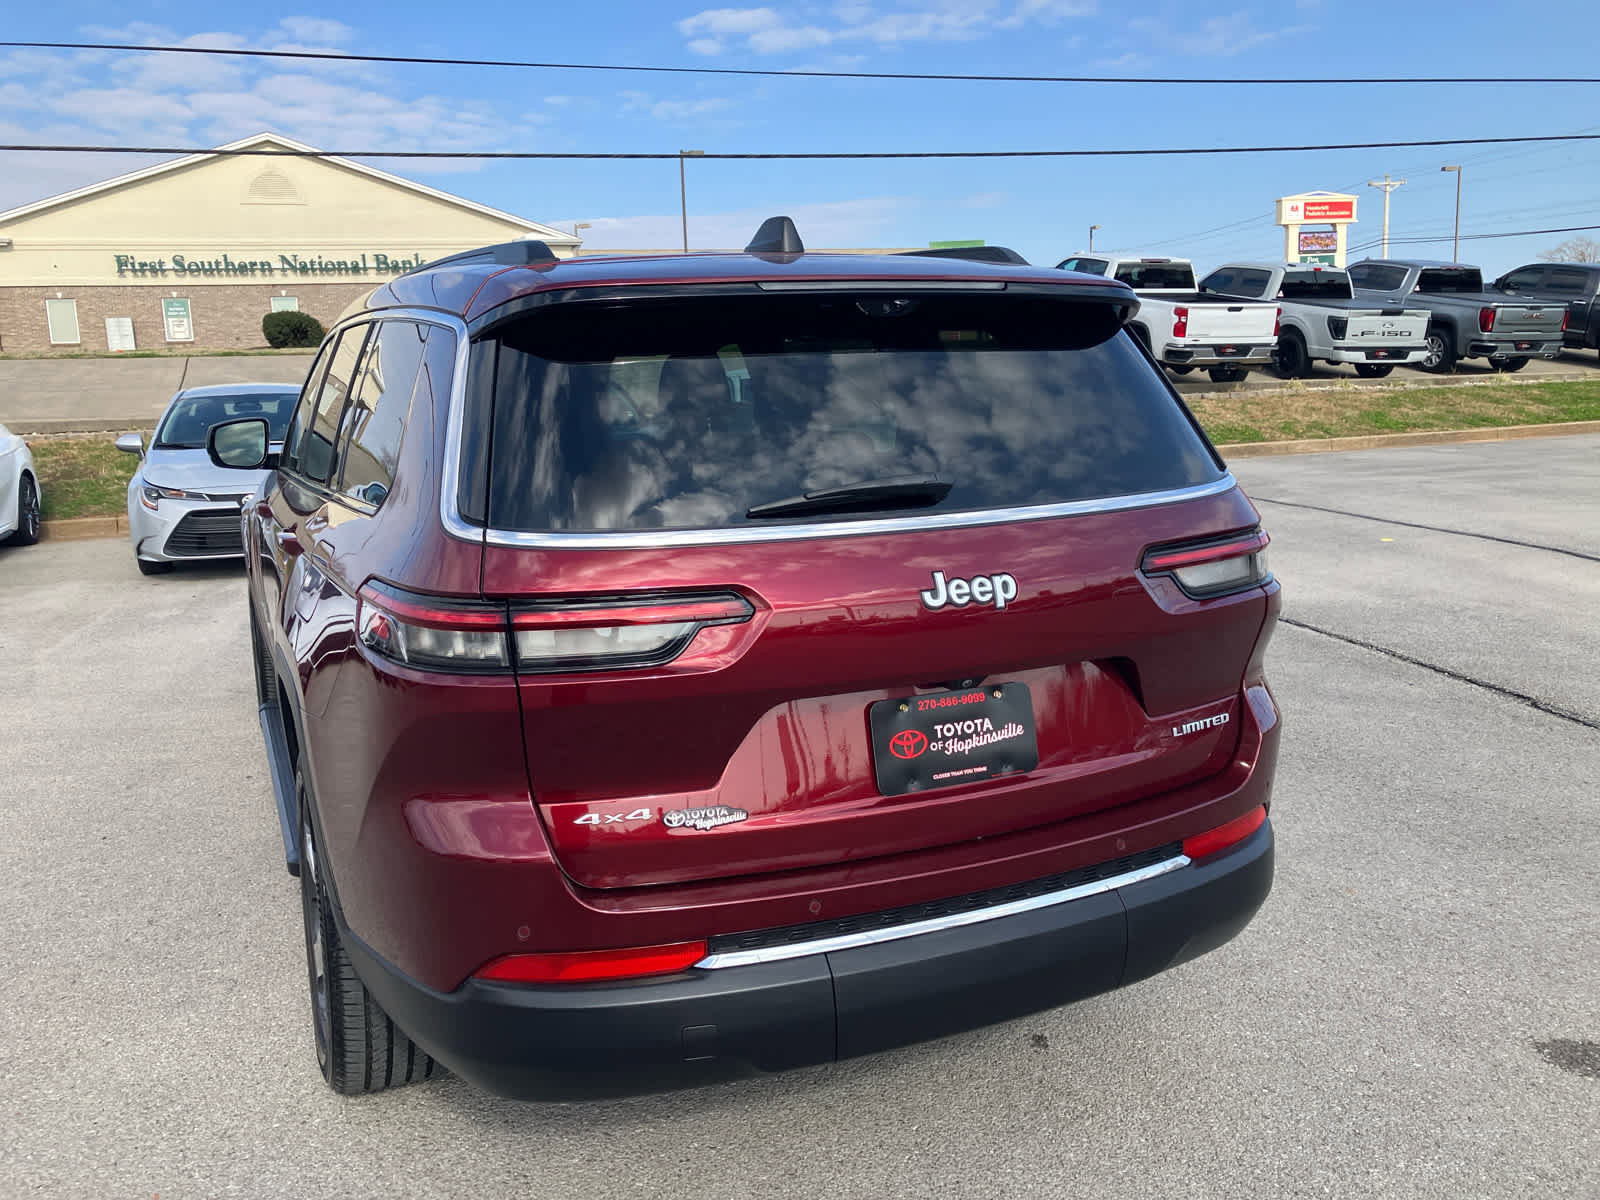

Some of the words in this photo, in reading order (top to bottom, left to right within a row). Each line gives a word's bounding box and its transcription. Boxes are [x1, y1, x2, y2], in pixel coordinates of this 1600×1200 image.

[113, 254, 166, 273] First
[172, 254, 273, 273] Southern
[278, 254, 368, 273] National
[373, 253, 426, 273] Bank
[920, 570, 1018, 610] Jeep
[934, 717, 994, 739] TOYOTA
[1172, 712, 1230, 737] LIMITED
[929, 740, 945, 752] OF
[944, 722, 1025, 755] Hopkinsville
[685, 807, 729, 819] TOYOTA
